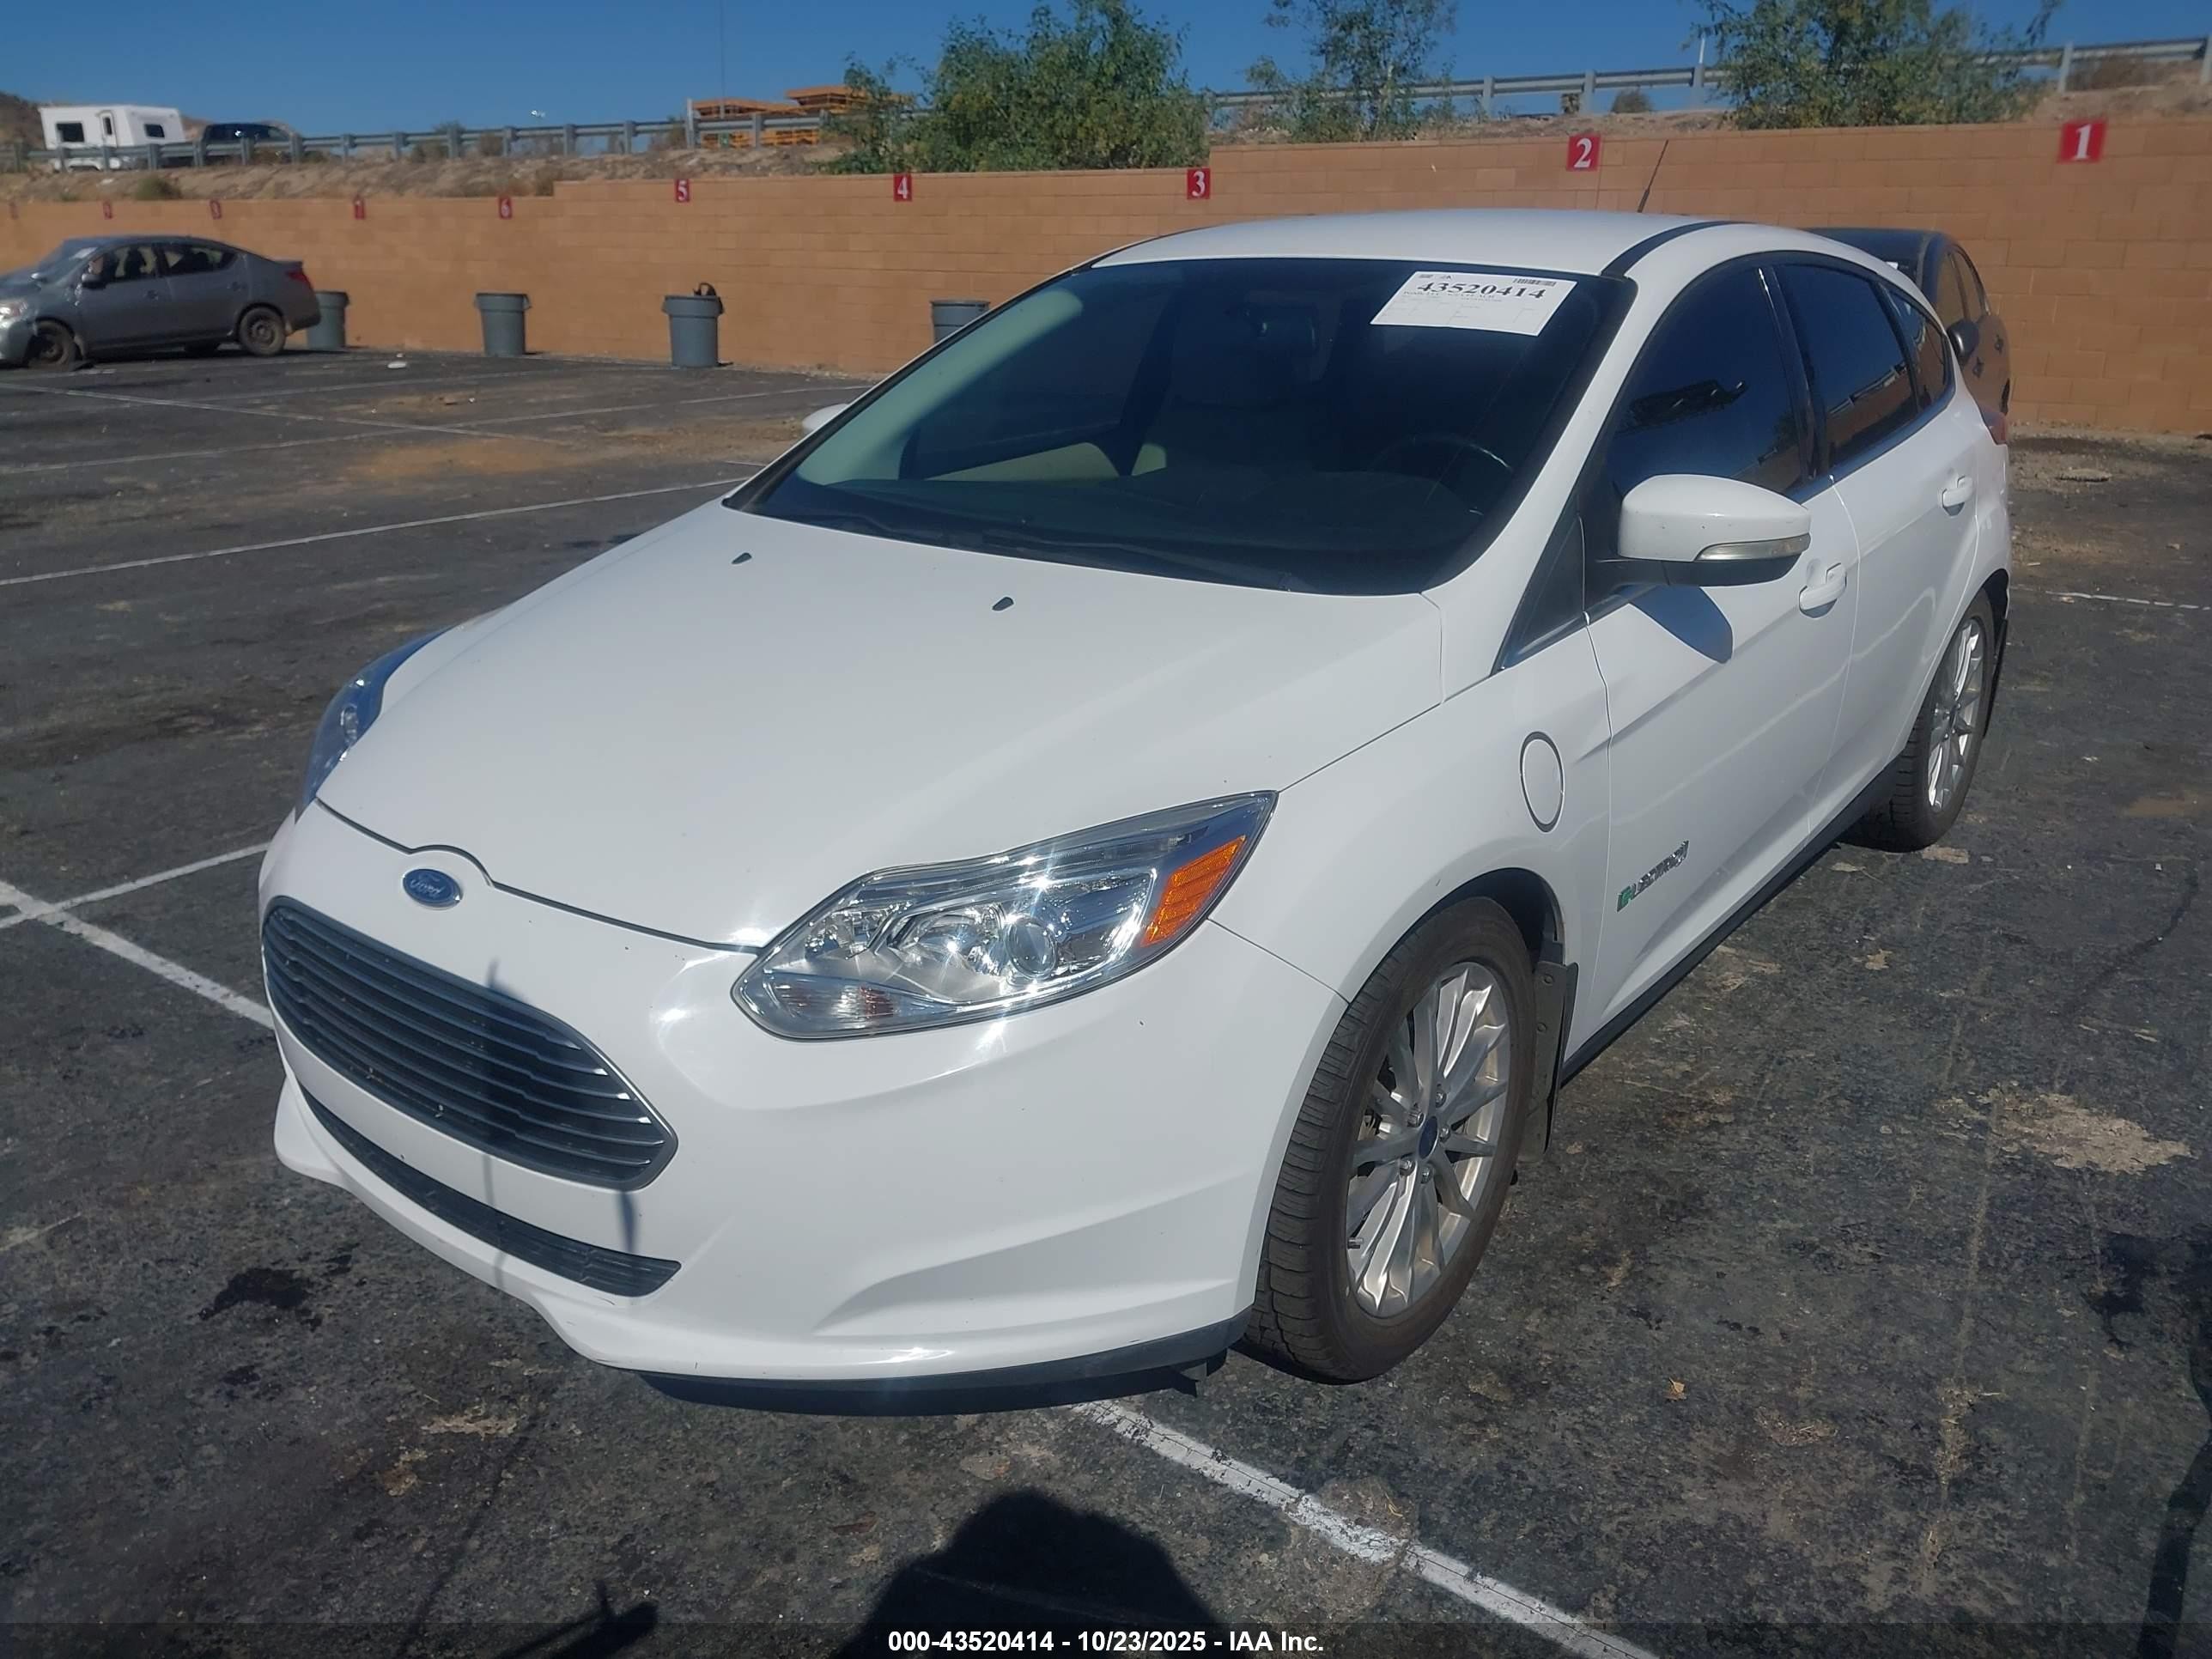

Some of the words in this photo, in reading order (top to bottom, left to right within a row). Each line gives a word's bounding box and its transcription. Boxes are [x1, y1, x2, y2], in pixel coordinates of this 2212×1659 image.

[1573, 137, 1592, 168] 2
[2070, 124, 2092, 160] 1
[678, 179, 688, 202] 5
[896, 176, 908, 199] 4
[1192, 171, 1206, 197] 3
[1417, 282, 1547, 300] 43520414
